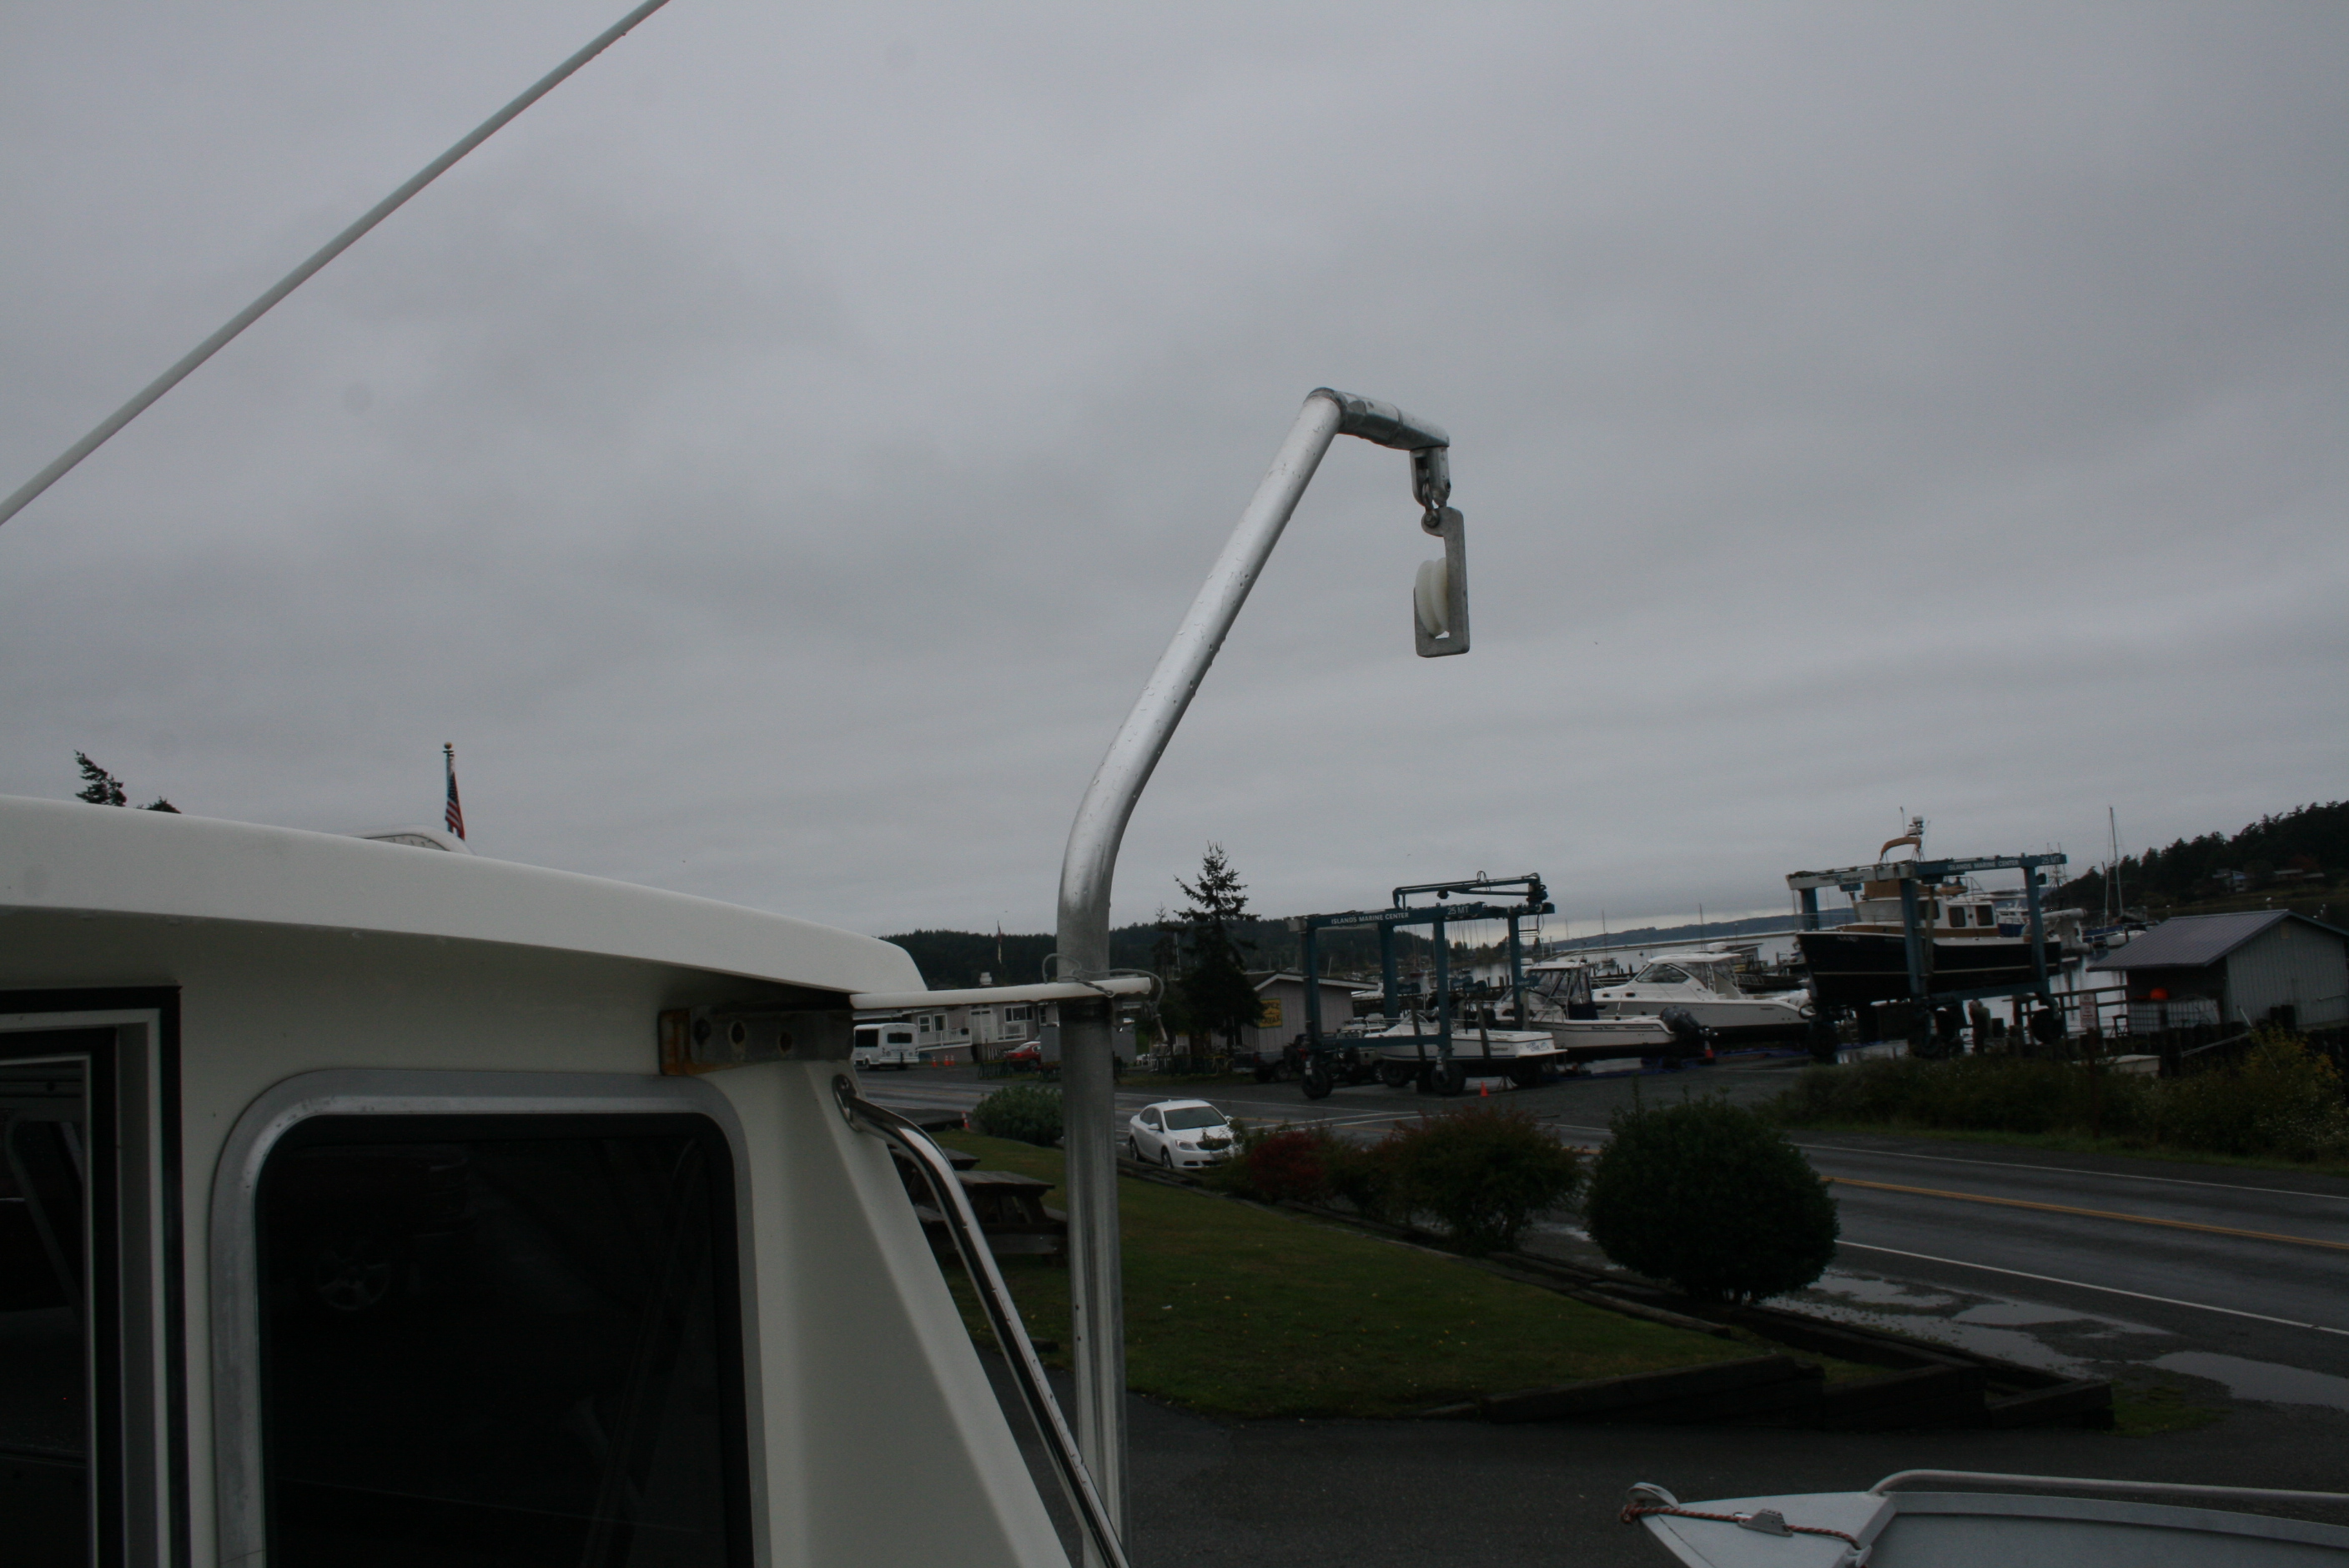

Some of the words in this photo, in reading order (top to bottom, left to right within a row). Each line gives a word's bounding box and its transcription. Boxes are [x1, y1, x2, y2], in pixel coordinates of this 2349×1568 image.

[1947, 862, 1972, 872] ISLANDS
[1974, 861, 1996, 869] MARINE
[1998, 859, 2020, 867] CENTER
[2041, 857, 2050, 865] 25
[1447, 907, 1456, 916] 25
[1457, 905, 1469, 914] MT
[1330, 917, 1357, 925] ISLANDS
[1359, 914, 1383, 922] MARINE
[1385, 912, 1409, 920] CENTER
